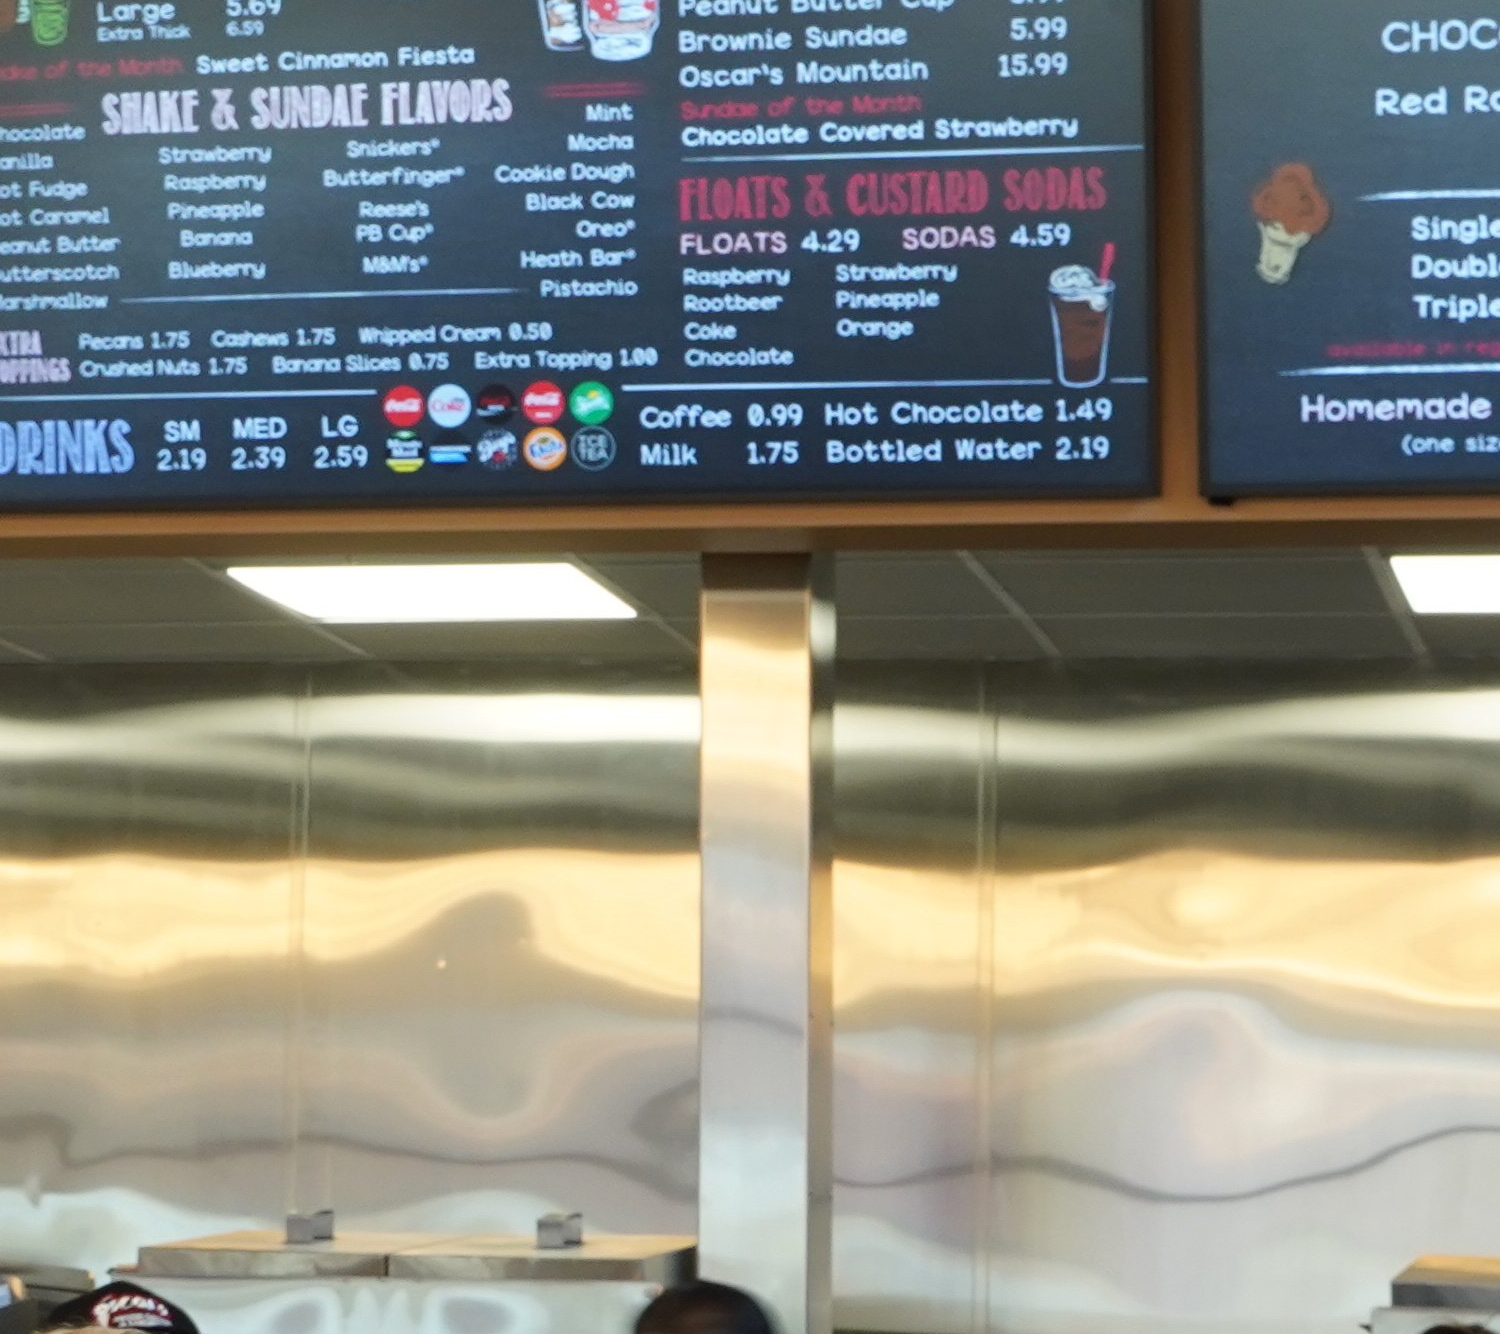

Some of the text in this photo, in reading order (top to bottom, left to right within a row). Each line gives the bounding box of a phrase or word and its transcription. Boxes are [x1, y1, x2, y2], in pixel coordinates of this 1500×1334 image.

[98, 2, 175, 26] Large
[197, 46, 475, 74] Sweet Cinnamon Fiesta
[999, 52, 1068, 77] 15.99
[679, 59, 929, 87] Oscar's Mountain
[102, 78, 512, 135] SHAKE & SUNDAE FLAVORS
[1376, 87, 1447, 116] Red
[682, 117, 1078, 147] Chocolate Covered Strawberry
[158, 146, 272, 165] Strawberry
[29, 181, 88, 200] Fudge
[164, 174, 266, 193] Raspberry
[679, 166, 1106, 221] FLOATS & CUSTARD SODAS
[680, 229, 860, 255] FLOATS 4.29
[903, 223, 1071, 250] SODAS 4.59
[640, 403, 803, 429] Coffee 0.99
[825, 398, 1112, 425] Hot Chocolate 1.49
[1301, 393, 1491, 422] Homemade
[164, 419, 200, 443] SM
[233, 417, 287, 439] MED
[322, 415, 359, 437] LG
[314, 445, 368, 469] 2.59
[640, 441, 799, 465] Milk 1.75
[826, 436, 1109, 463] Bottled Water 2.19
[1401, 434, 1455, 456] (one
[157, 448, 206, 471] 2.19
[232, 446, 285, 470] 2.39
